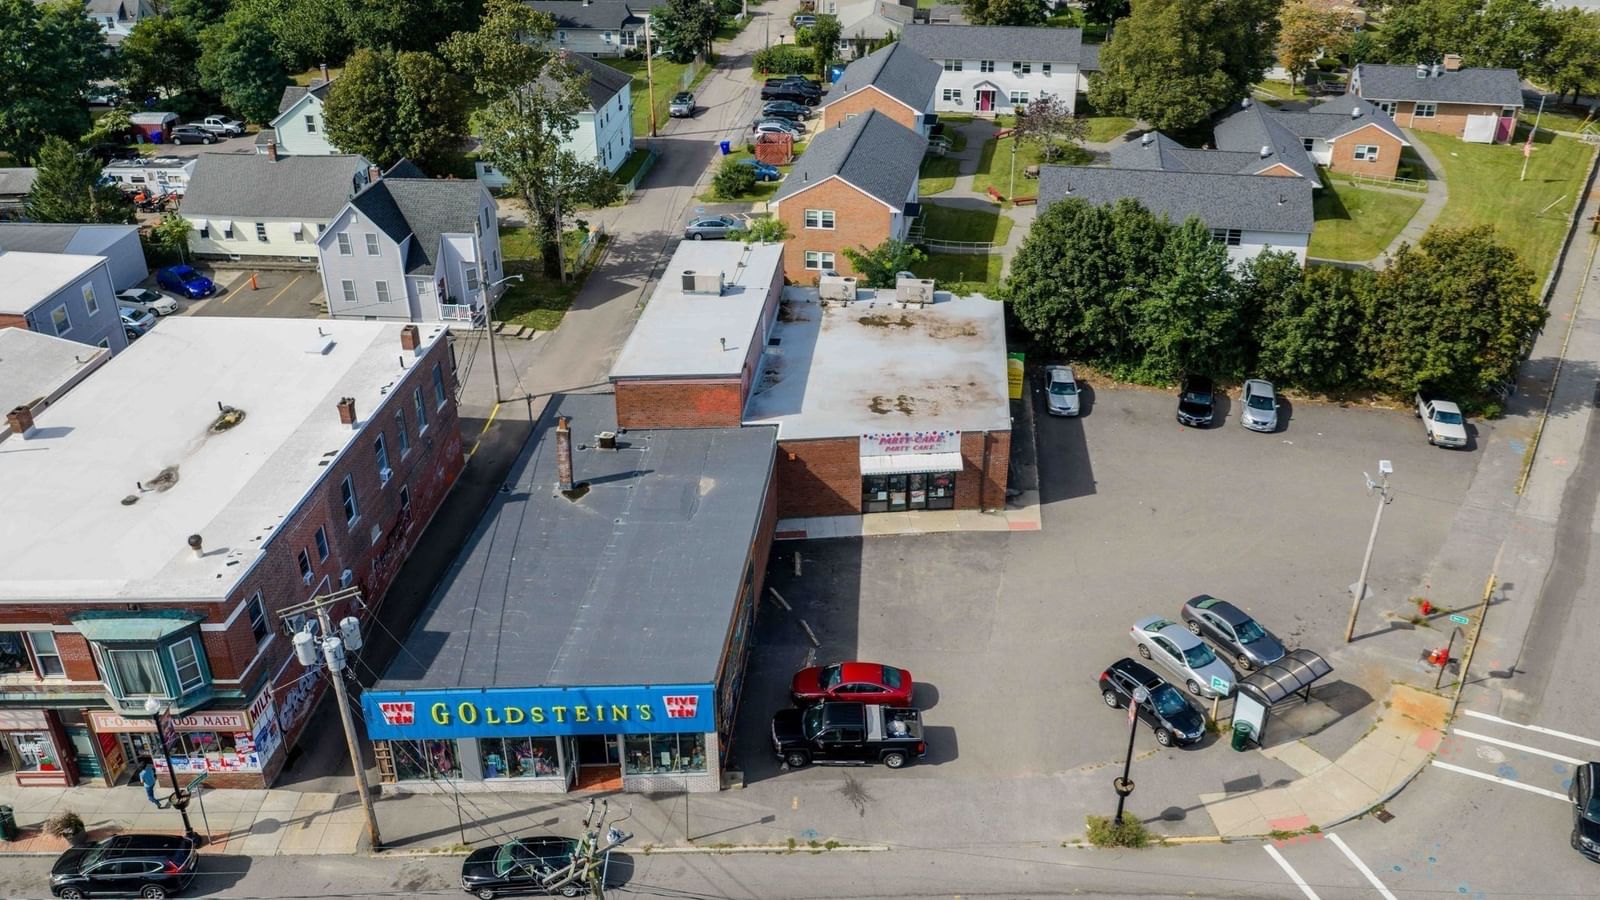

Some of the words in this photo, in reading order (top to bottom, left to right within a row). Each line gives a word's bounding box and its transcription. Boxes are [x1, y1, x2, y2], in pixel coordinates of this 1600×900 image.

[250, 687, 272, 723] MILK
[666, 697, 697, 706] FIVE
[382, 703, 413, 712] FIVE
[431, 702, 651, 725] GOLDSTEIN'S
[669, 709, 694, 718] TEN
[172, 716, 198, 726] OOD
[203, 717, 239, 726] MART
[388, 715, 413, 724] TEN
